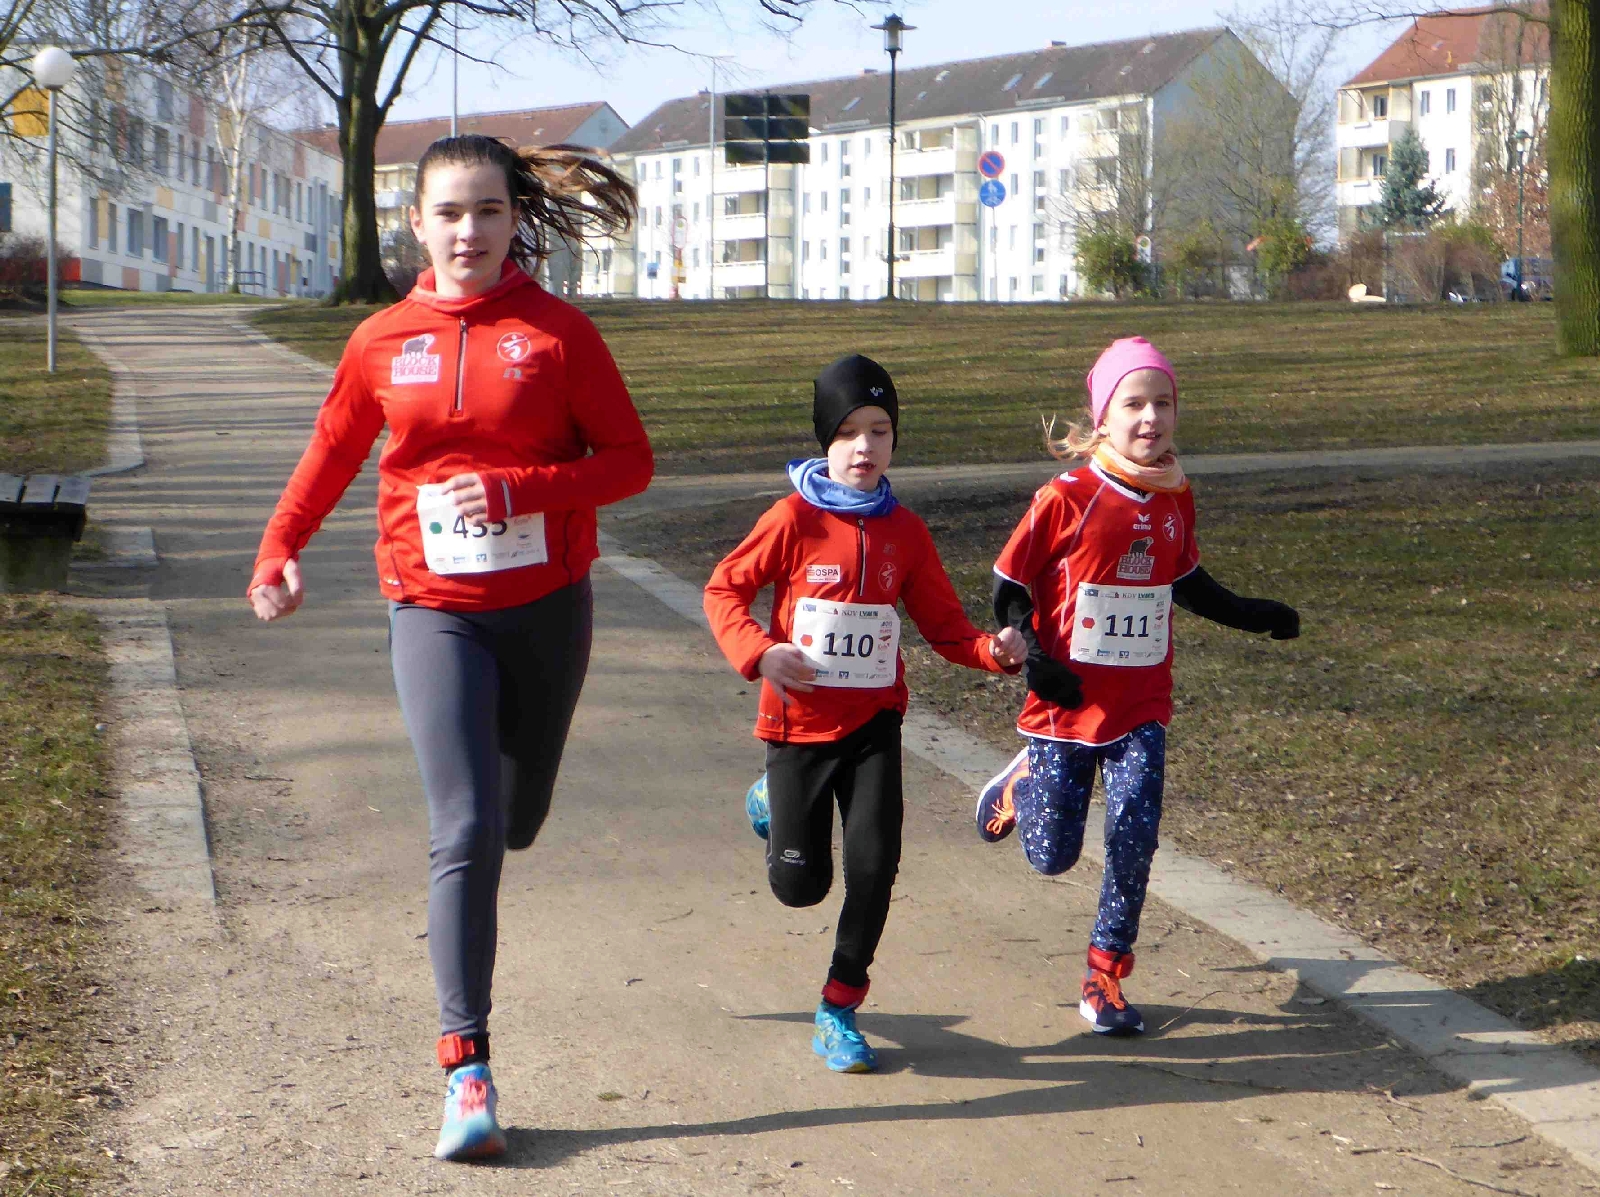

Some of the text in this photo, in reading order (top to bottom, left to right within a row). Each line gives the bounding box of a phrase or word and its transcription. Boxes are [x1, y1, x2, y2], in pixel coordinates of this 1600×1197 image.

[393, 356, 437, 367] BLOCK
[393, 366, 437, 377] HOUSE
[1121, 556, 1152, 566] BLOCK
[1117, 565, 1151, 574] HOUSE
[1104, 614, 1149, 637] 111
[823, 632, 874, 657] 110
